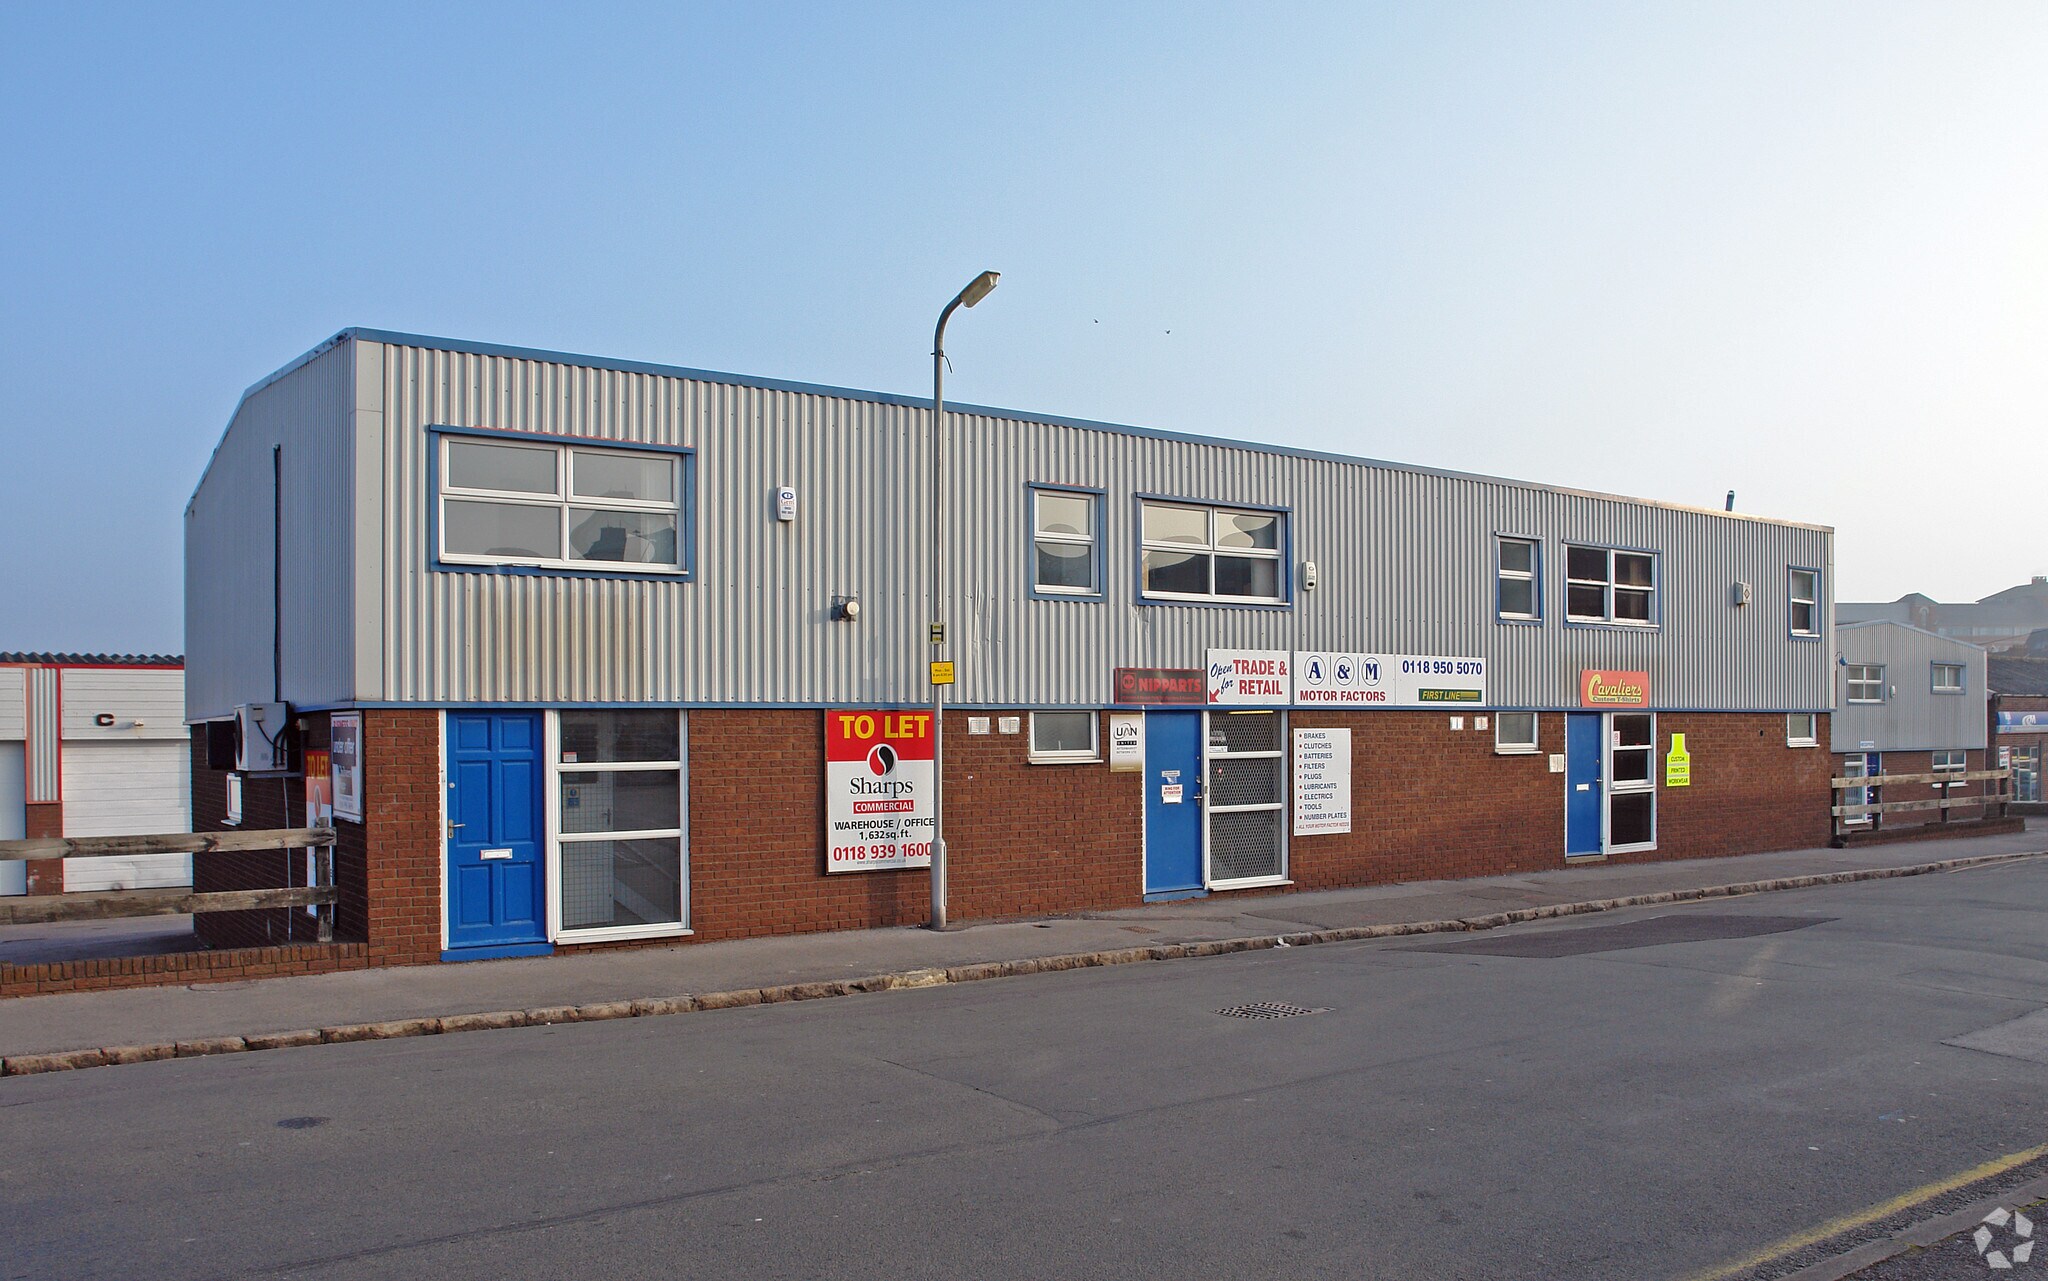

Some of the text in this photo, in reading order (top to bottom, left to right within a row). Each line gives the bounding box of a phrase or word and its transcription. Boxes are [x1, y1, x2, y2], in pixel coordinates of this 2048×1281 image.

[930, 624, 944, 642] H
[1210, 660, 1288, 679] Open TRADE &
[1308, 662, 1379, 680] A & M
[1402, 660, 1483, 675] 0118 950 5070
[1138, 678, 1202, 693] NIPPARTS
[1220, 678, 1283, 695] for RETAIL
[1588, 674, 1642, 702] Cavaliers
[1300, 690, 1386, 701] MOTOR FACTORS
[1422, 691, 1461, 700] FIRST LINE
[95, 713, 115, 727] C
[838, 715, 930, 739] TO LET
[1116, 727, 1138, 737] UAN
[307, 755, 329, 780] TO LET
[850, 777, 913, 799] Sharps
[855, 802, 913, 812] COMMERCIAL
[834, 818, 935, 831] WAREHOUSE / OFFICE
[859, 829, 912, 840] 1,632sq.ft.
[833, 842, 932, 861] 0118 939 1600
